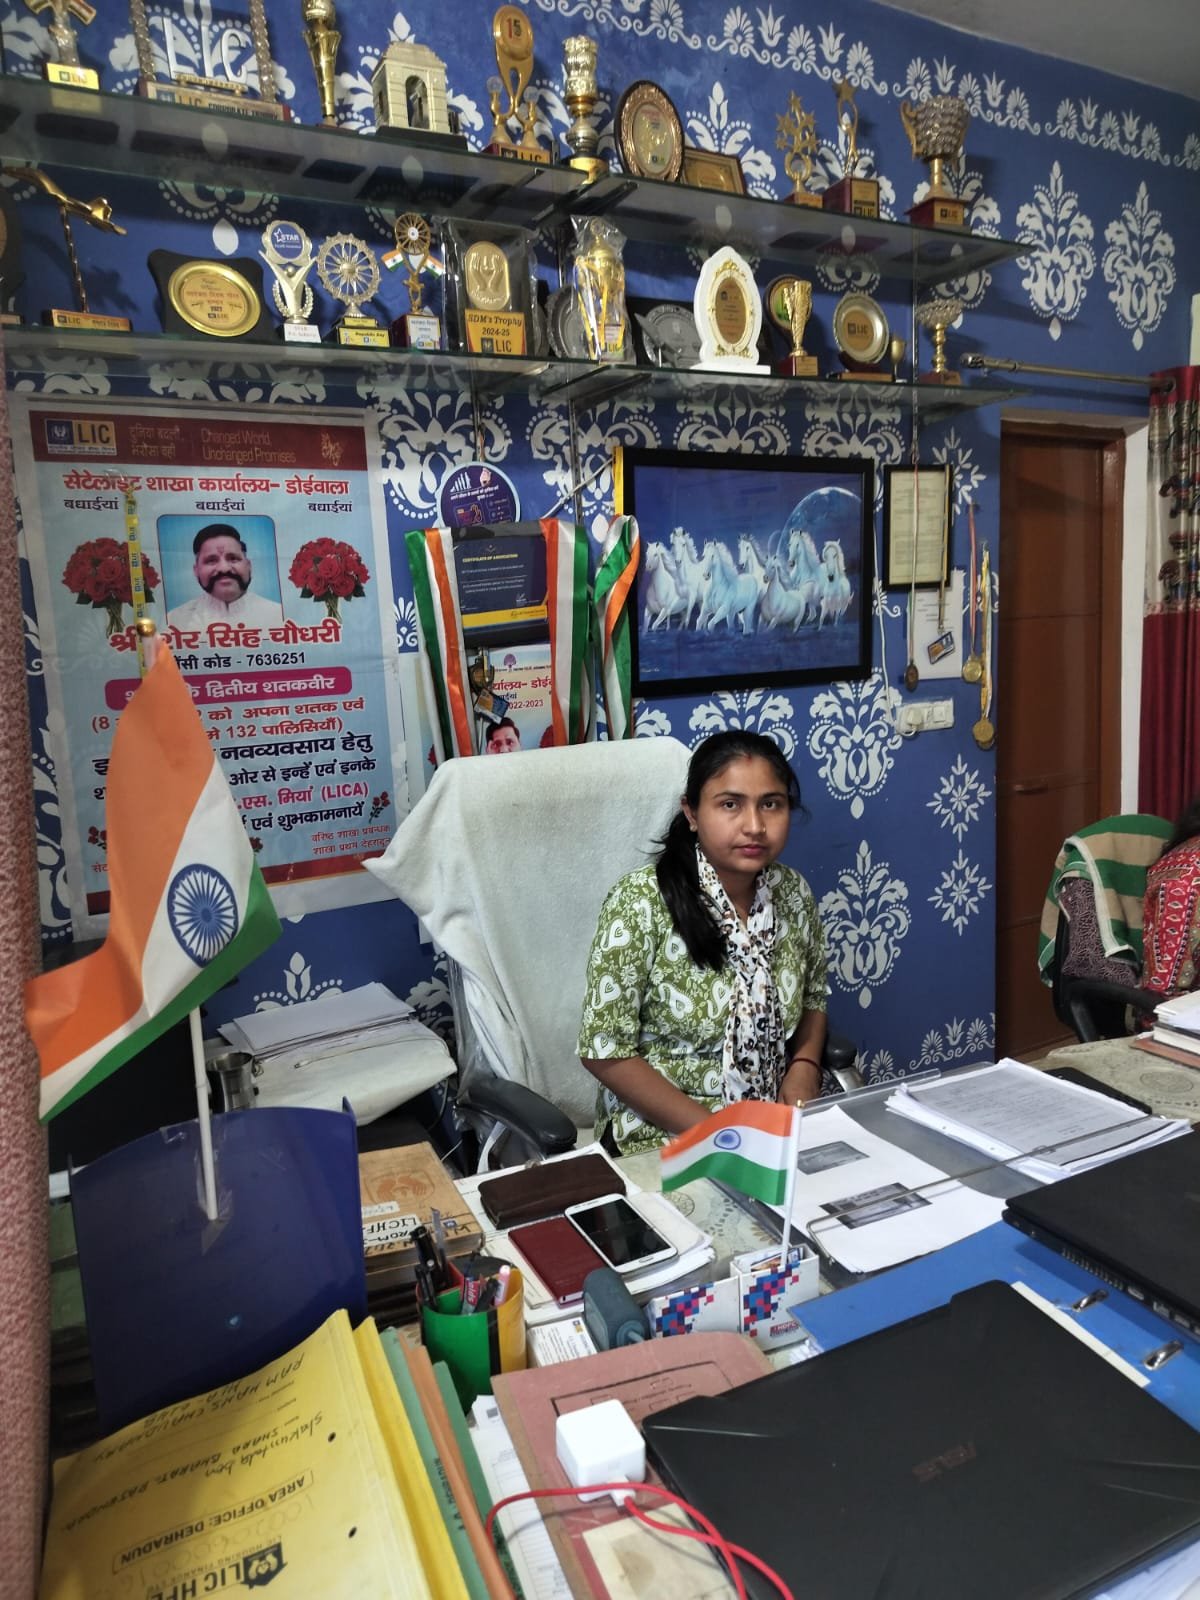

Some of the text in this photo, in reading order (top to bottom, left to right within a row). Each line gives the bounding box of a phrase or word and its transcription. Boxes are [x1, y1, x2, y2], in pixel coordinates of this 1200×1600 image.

[506, 17, 522, 39] 15
[162, 17, 250, 85] LIC
[482, 327, 510, 336] 2024-25
[494, 316, 522, 327] Trophy
[496, 339, 512, 353] LIC
[77, 423, 111, 444] LIC
[201, 428, 240, 447] Changed
[203, 449, 296, 465] Unchanged Promises
[146, 475, 195, 493] शाखा
[286, 476, 349, 495] डोईवाला
[207, 622, 262, 649] सिंह
[269, 617, 342, 645] चौधरी
[203, 652, 231, 669] कोड
[247, 651, 306, 667] 7636251
[206, 680, 258, 698] द्वितीय
[262, 675, 336, 694] शतकवीर
[92, 697, 365, 734] (8 को अपना शतक एवं
[226, 725, 257, 739] 132
[220, 731, 373, 761] नवव्यवसाय हेतु
[229, 756, 377, 786] ओर से इन्हें एवं इनके
[278, 785, 314, 805] मियां
[321, 782, 369, 802] (LICA)
[252, 801, 366, 831] एवं शुभकामनायें
[120, 1475, 306, 1565] AREA OFFICE: DEHRADUN
[203, 1559, 242, 1592] LIC
